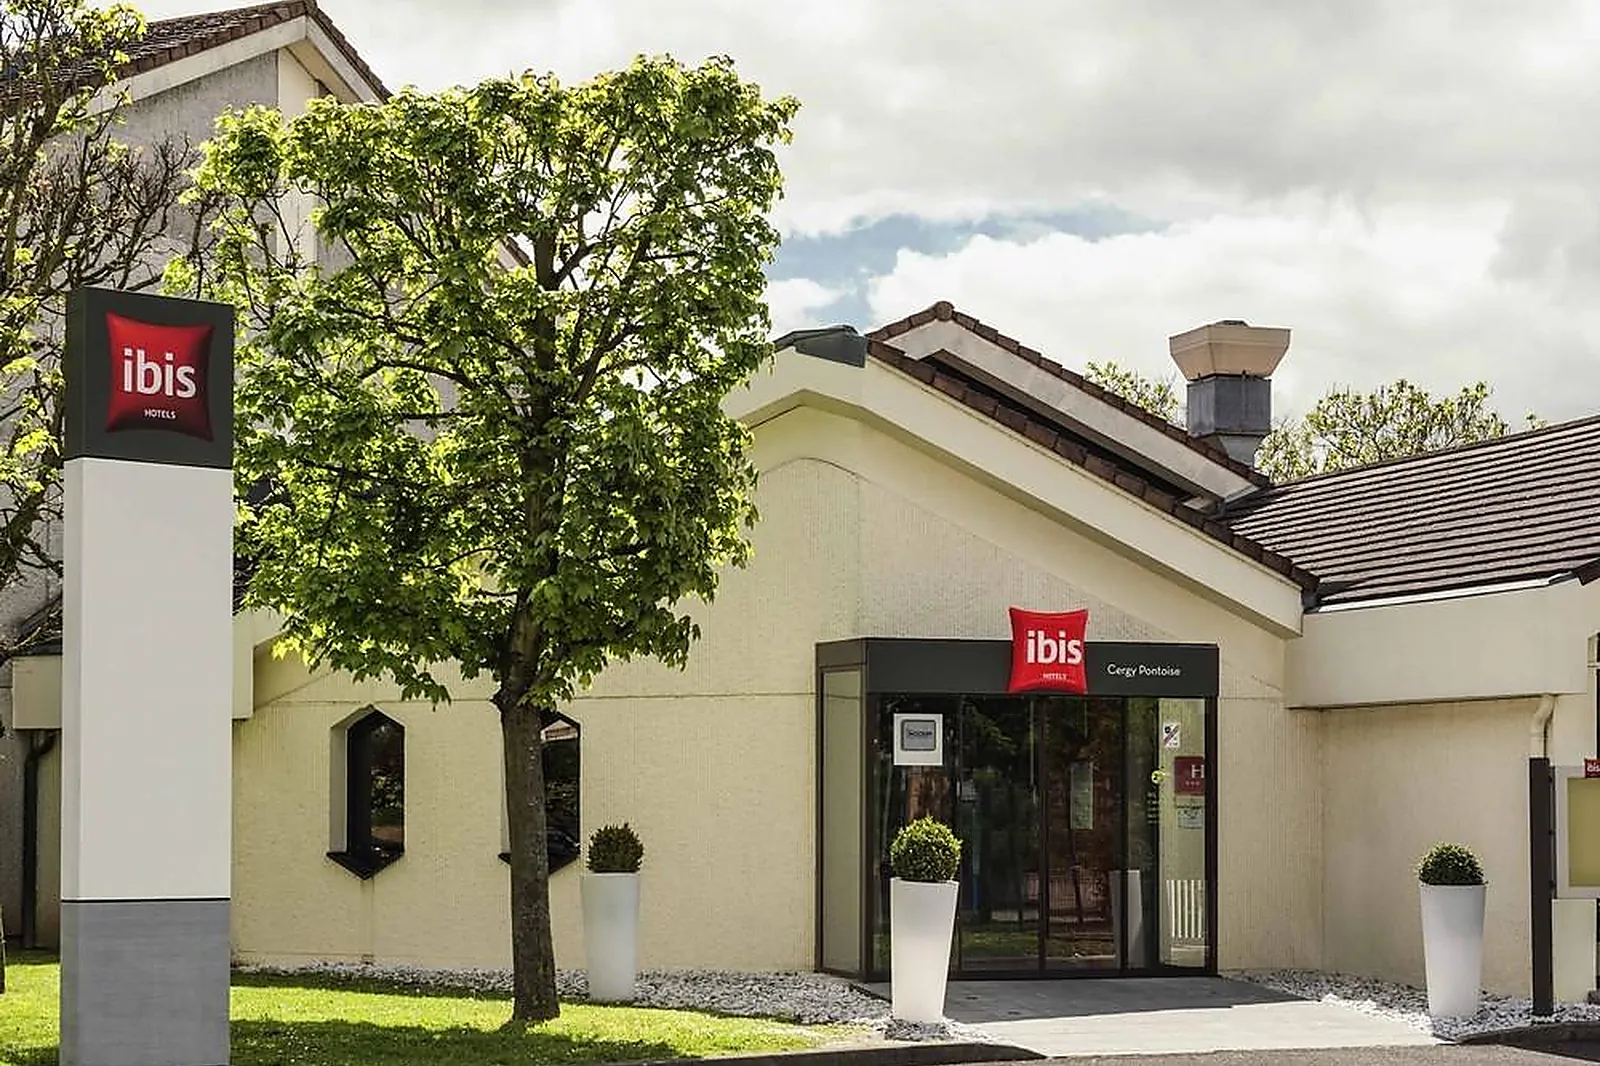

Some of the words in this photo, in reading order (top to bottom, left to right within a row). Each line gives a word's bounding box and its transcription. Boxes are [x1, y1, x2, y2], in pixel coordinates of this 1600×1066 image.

[124, 348, 196, 398] ibis
[144, 409, 176, 419] HOTELS
[1027, 630, 1082, 664] ibis
[1107, 663, 1137, 678] Cergy
[1139, 664, 1181, 676] Pontoise
[1191, 764, 1204, 779] H
